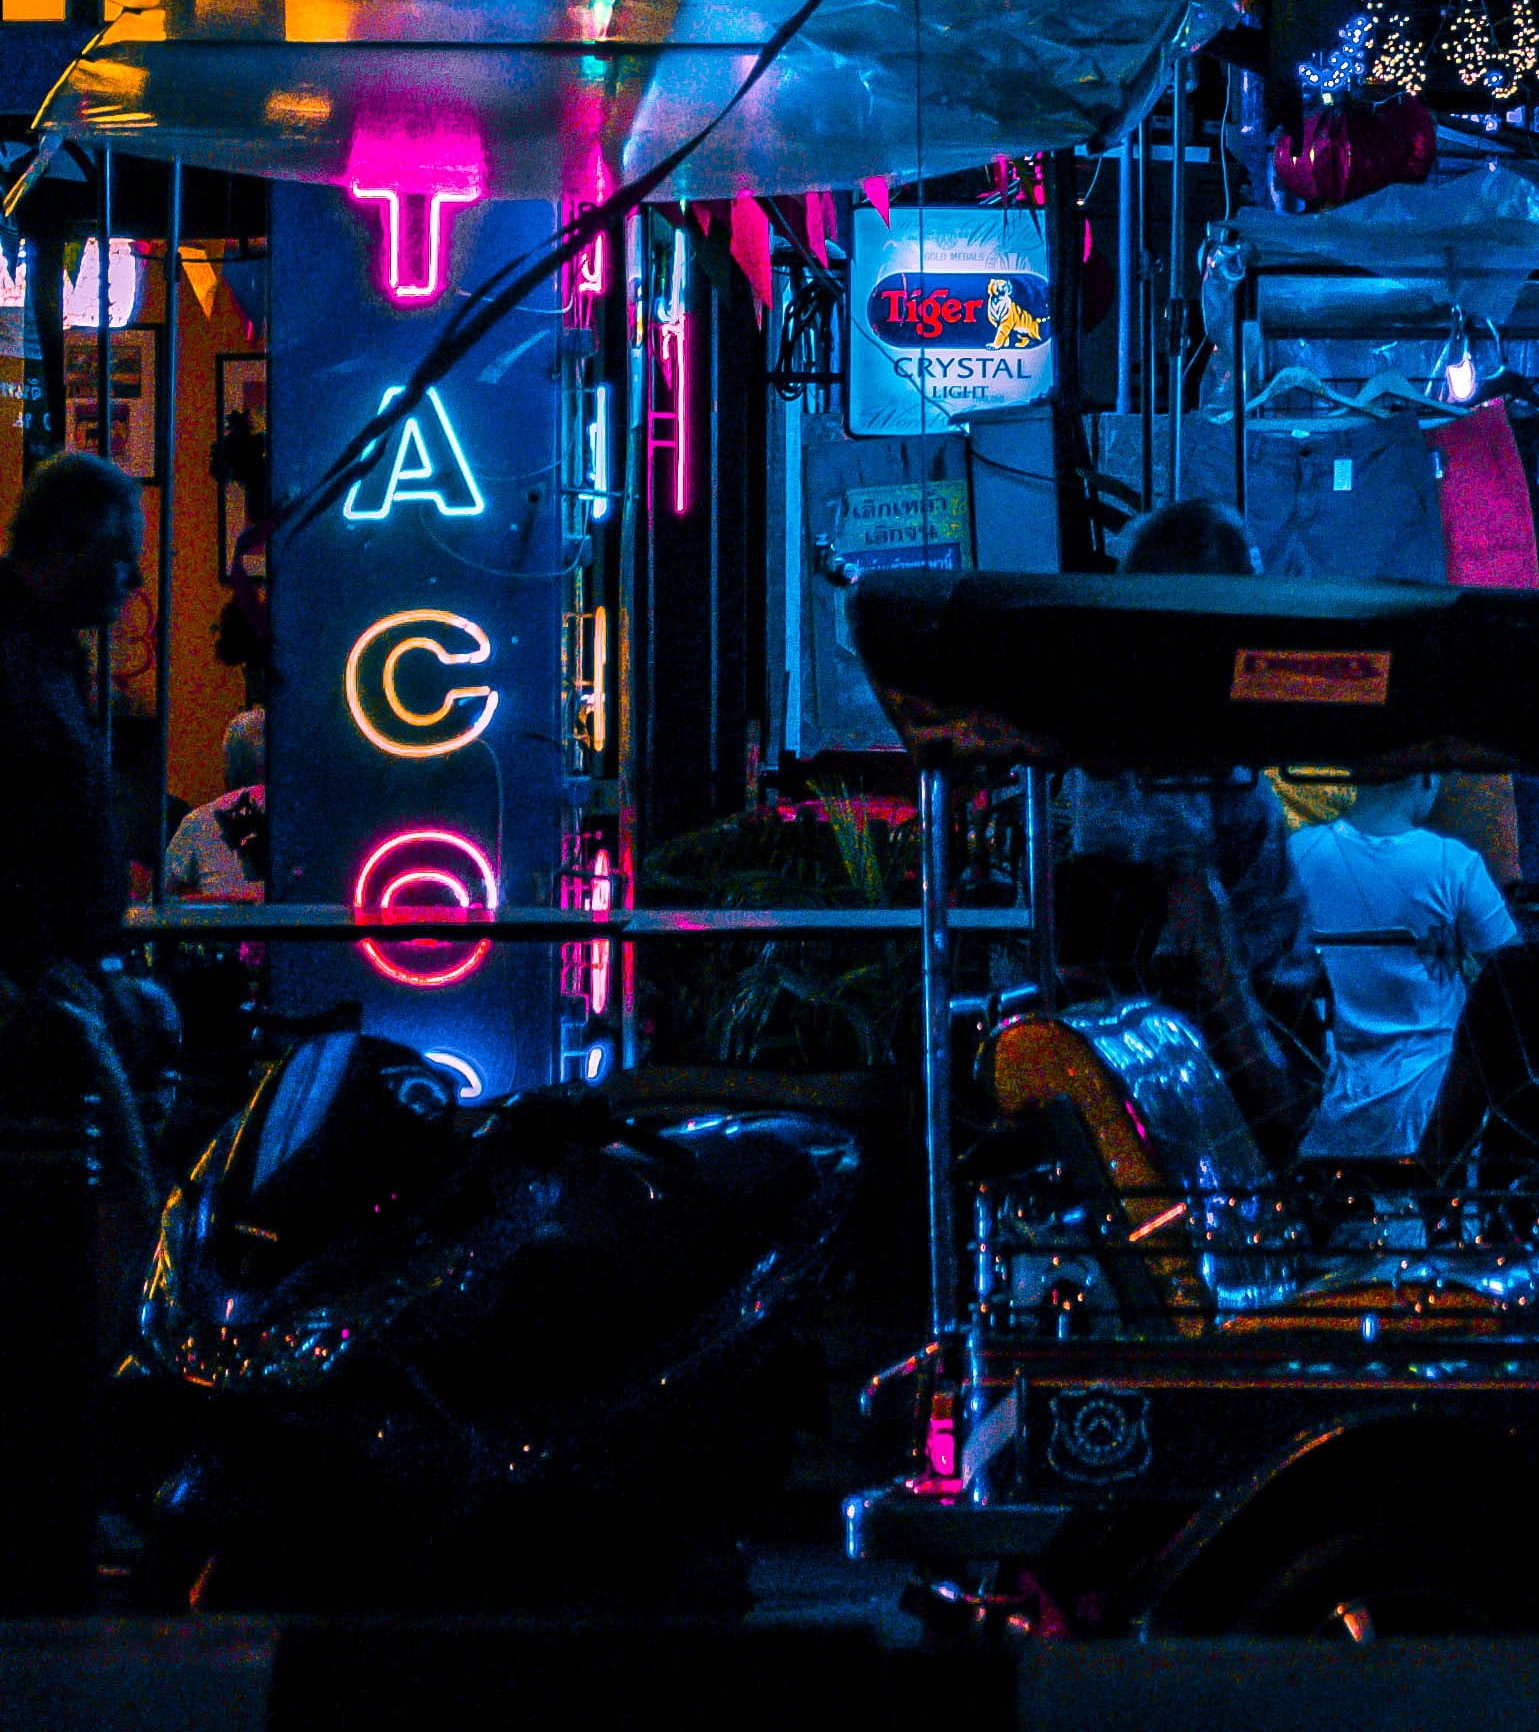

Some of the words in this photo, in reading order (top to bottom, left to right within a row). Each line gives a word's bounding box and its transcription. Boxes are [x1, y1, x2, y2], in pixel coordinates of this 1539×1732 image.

[880, 288, 984, 339] Tiger
[894, 357, 1032, 379] CRYSTAL
[932, 385, 990, 399] LIGHT
[343, 183, 499, 1099] TACO
